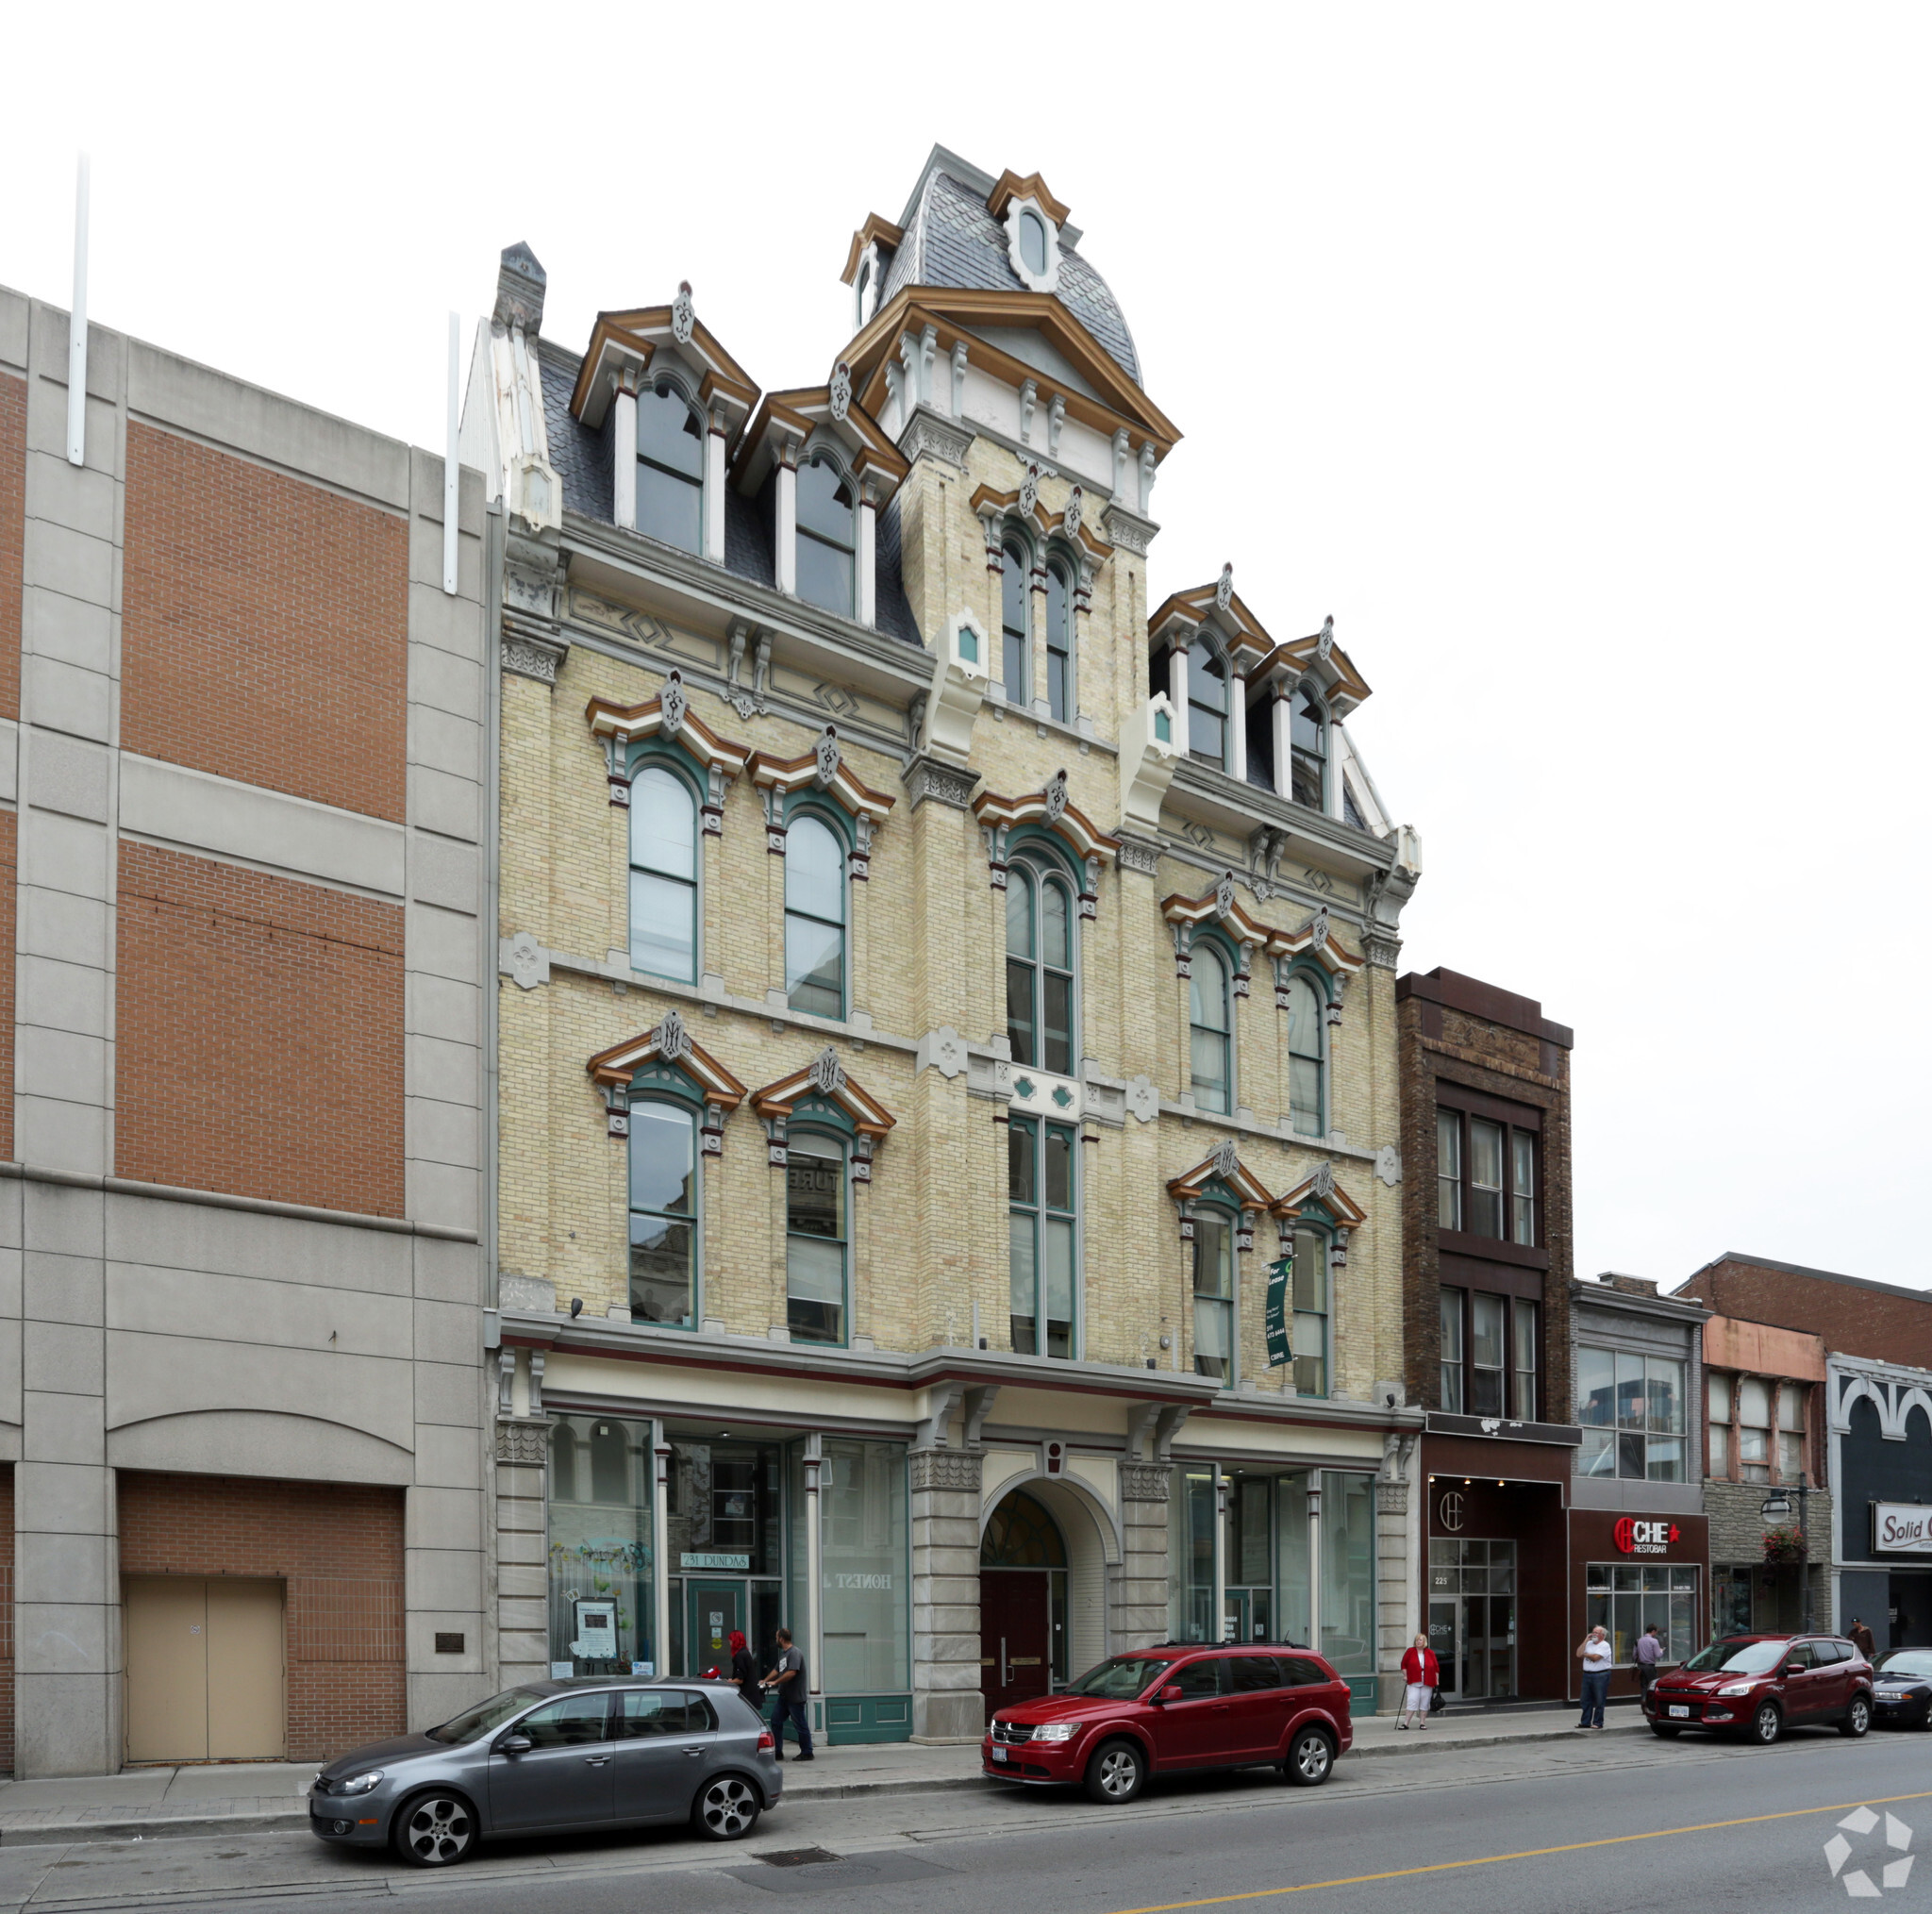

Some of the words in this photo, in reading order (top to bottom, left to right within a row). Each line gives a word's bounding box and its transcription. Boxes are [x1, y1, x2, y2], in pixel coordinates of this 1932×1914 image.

[1269, 1275, 1284, 1286] Lease
[1271, 1352, 1285, 1360] CBRE
[1633, 1521, 1669, 1543] CHE
[1882, 1515, 1924, 1542] Solid
[1634, 1544, 1667, 1554] RESTOBAR
[684, 1555, 699, 1566] 231
[704, 1556, 747, 1567] DUNDAS
